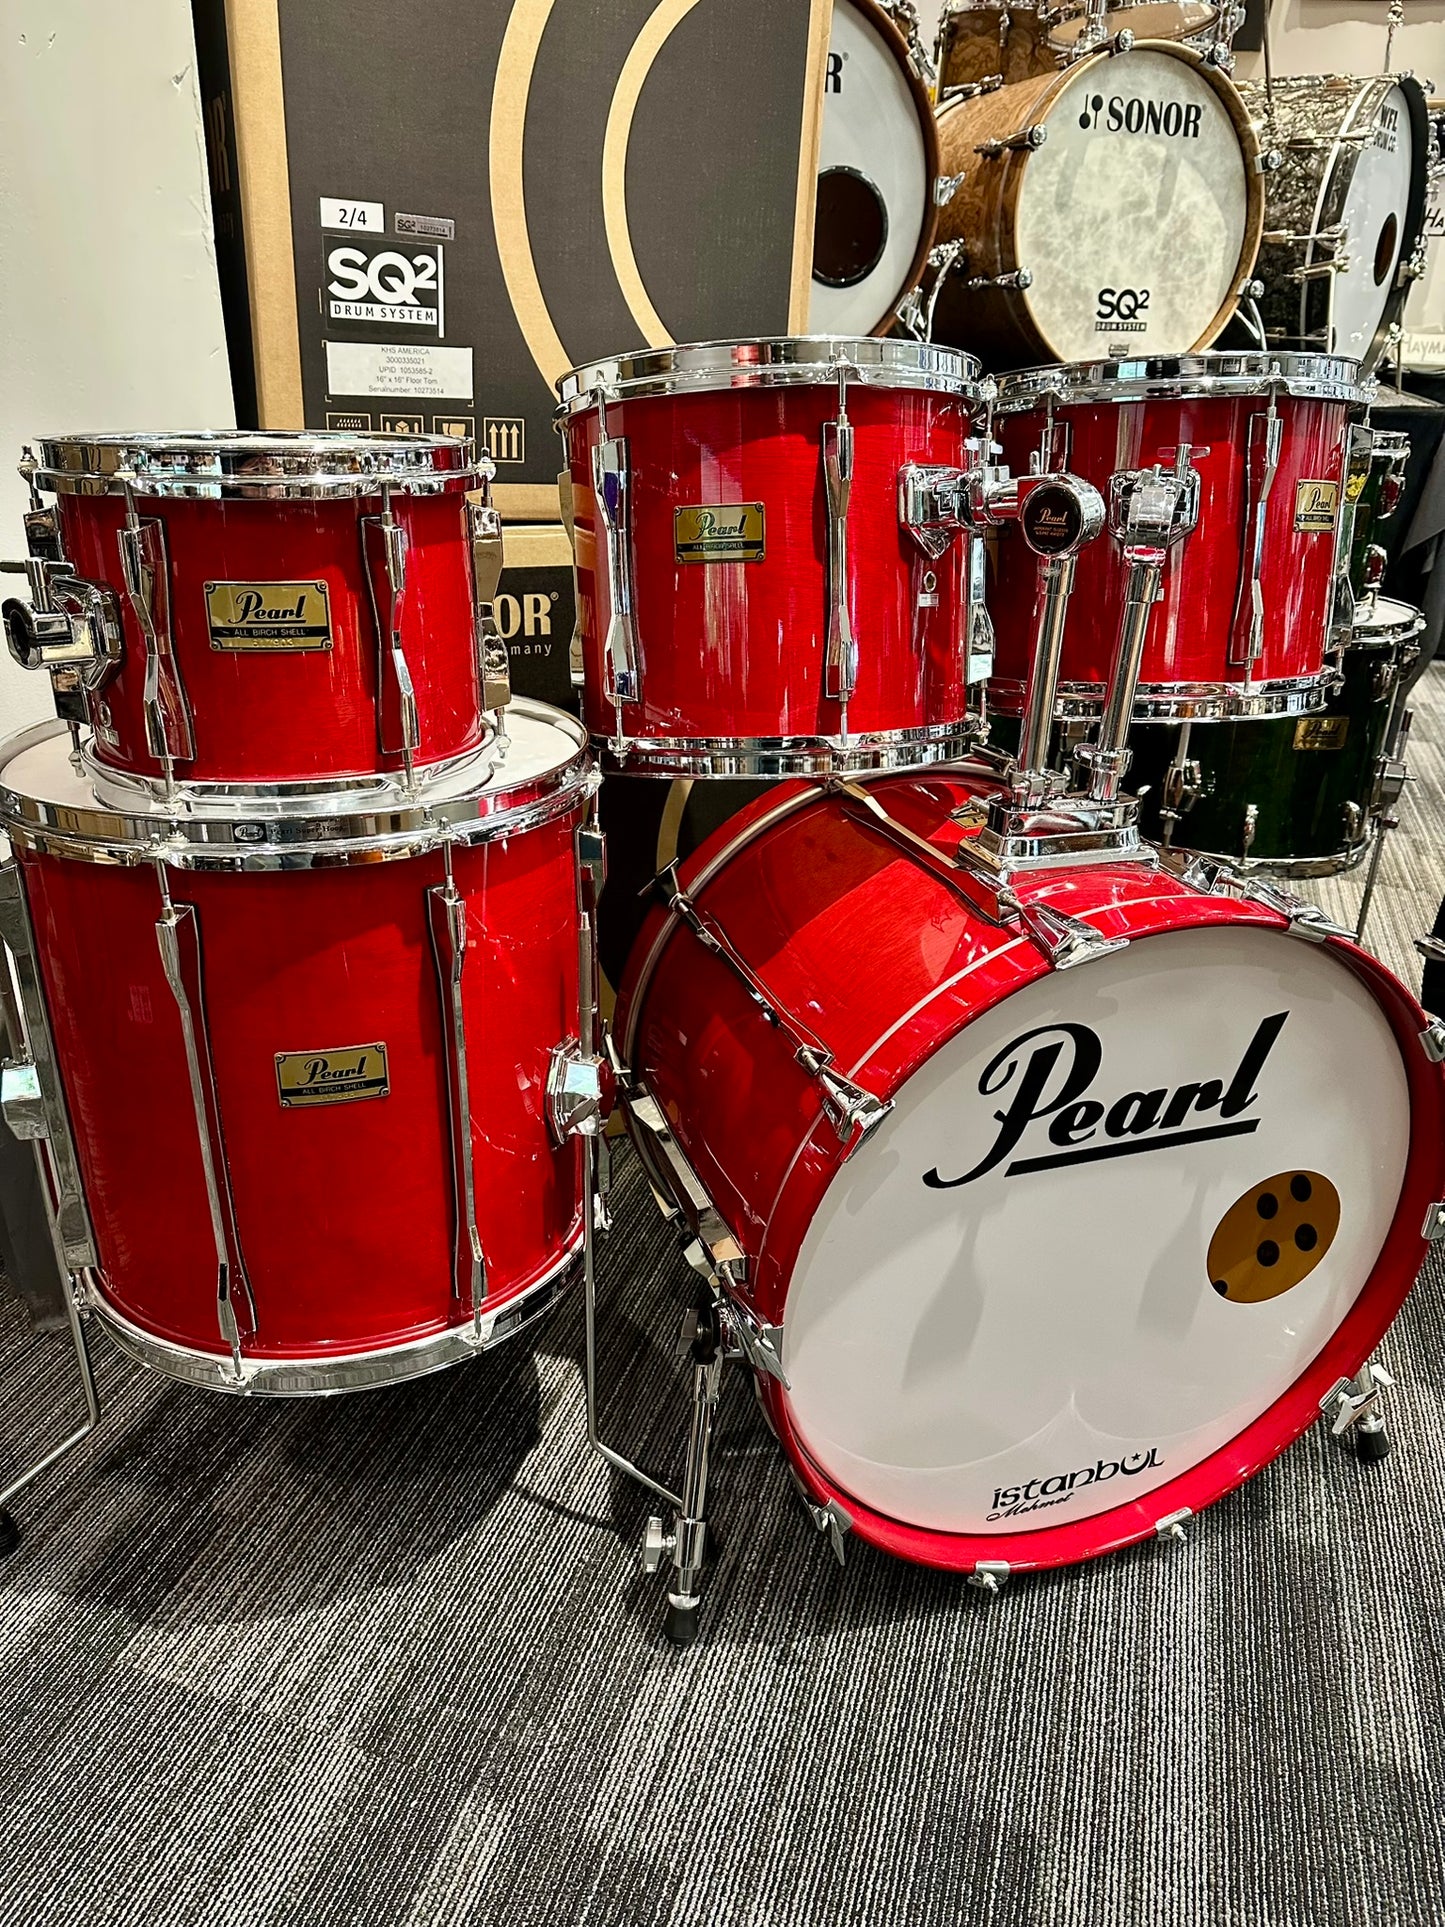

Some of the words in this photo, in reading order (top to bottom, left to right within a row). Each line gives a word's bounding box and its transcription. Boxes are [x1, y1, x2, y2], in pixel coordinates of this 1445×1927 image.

[1106, 96, 1202, 138] SONOR
[1380, 104, 1399, 132] WFL
[338, 207, 367, 227] 2/4
[327, 247, 438, 305] SQ2
[334, 304, 375, 317] DRUM
[380, 307, 434, 321] SYSTEM
[1096, 288, 1150, 320] SQ2
[381, 346, 397, 354] KHS
[397, 347, 430, 355] AMERICA
[423, 377, 438, 385] Tom
[1305, 487, 1334, 512] Pearl
[689, 511, 748, 541] Pearl
[1035, 507, 1068, 525] Pearl
[228, 590, 307, 624] Pearl
[234, 628, 249, 636] ALL
[252, 628, 278, 636] BIRCH
[280, 628, 306, 636] SHELL
[296, 1056, 368, 1086] Pearl
[318, 1085, 342, 1094] BIRCH
[343, 1081, 367, 1091] SHELL
[922, 1010, 1290, 1189] Pearl
